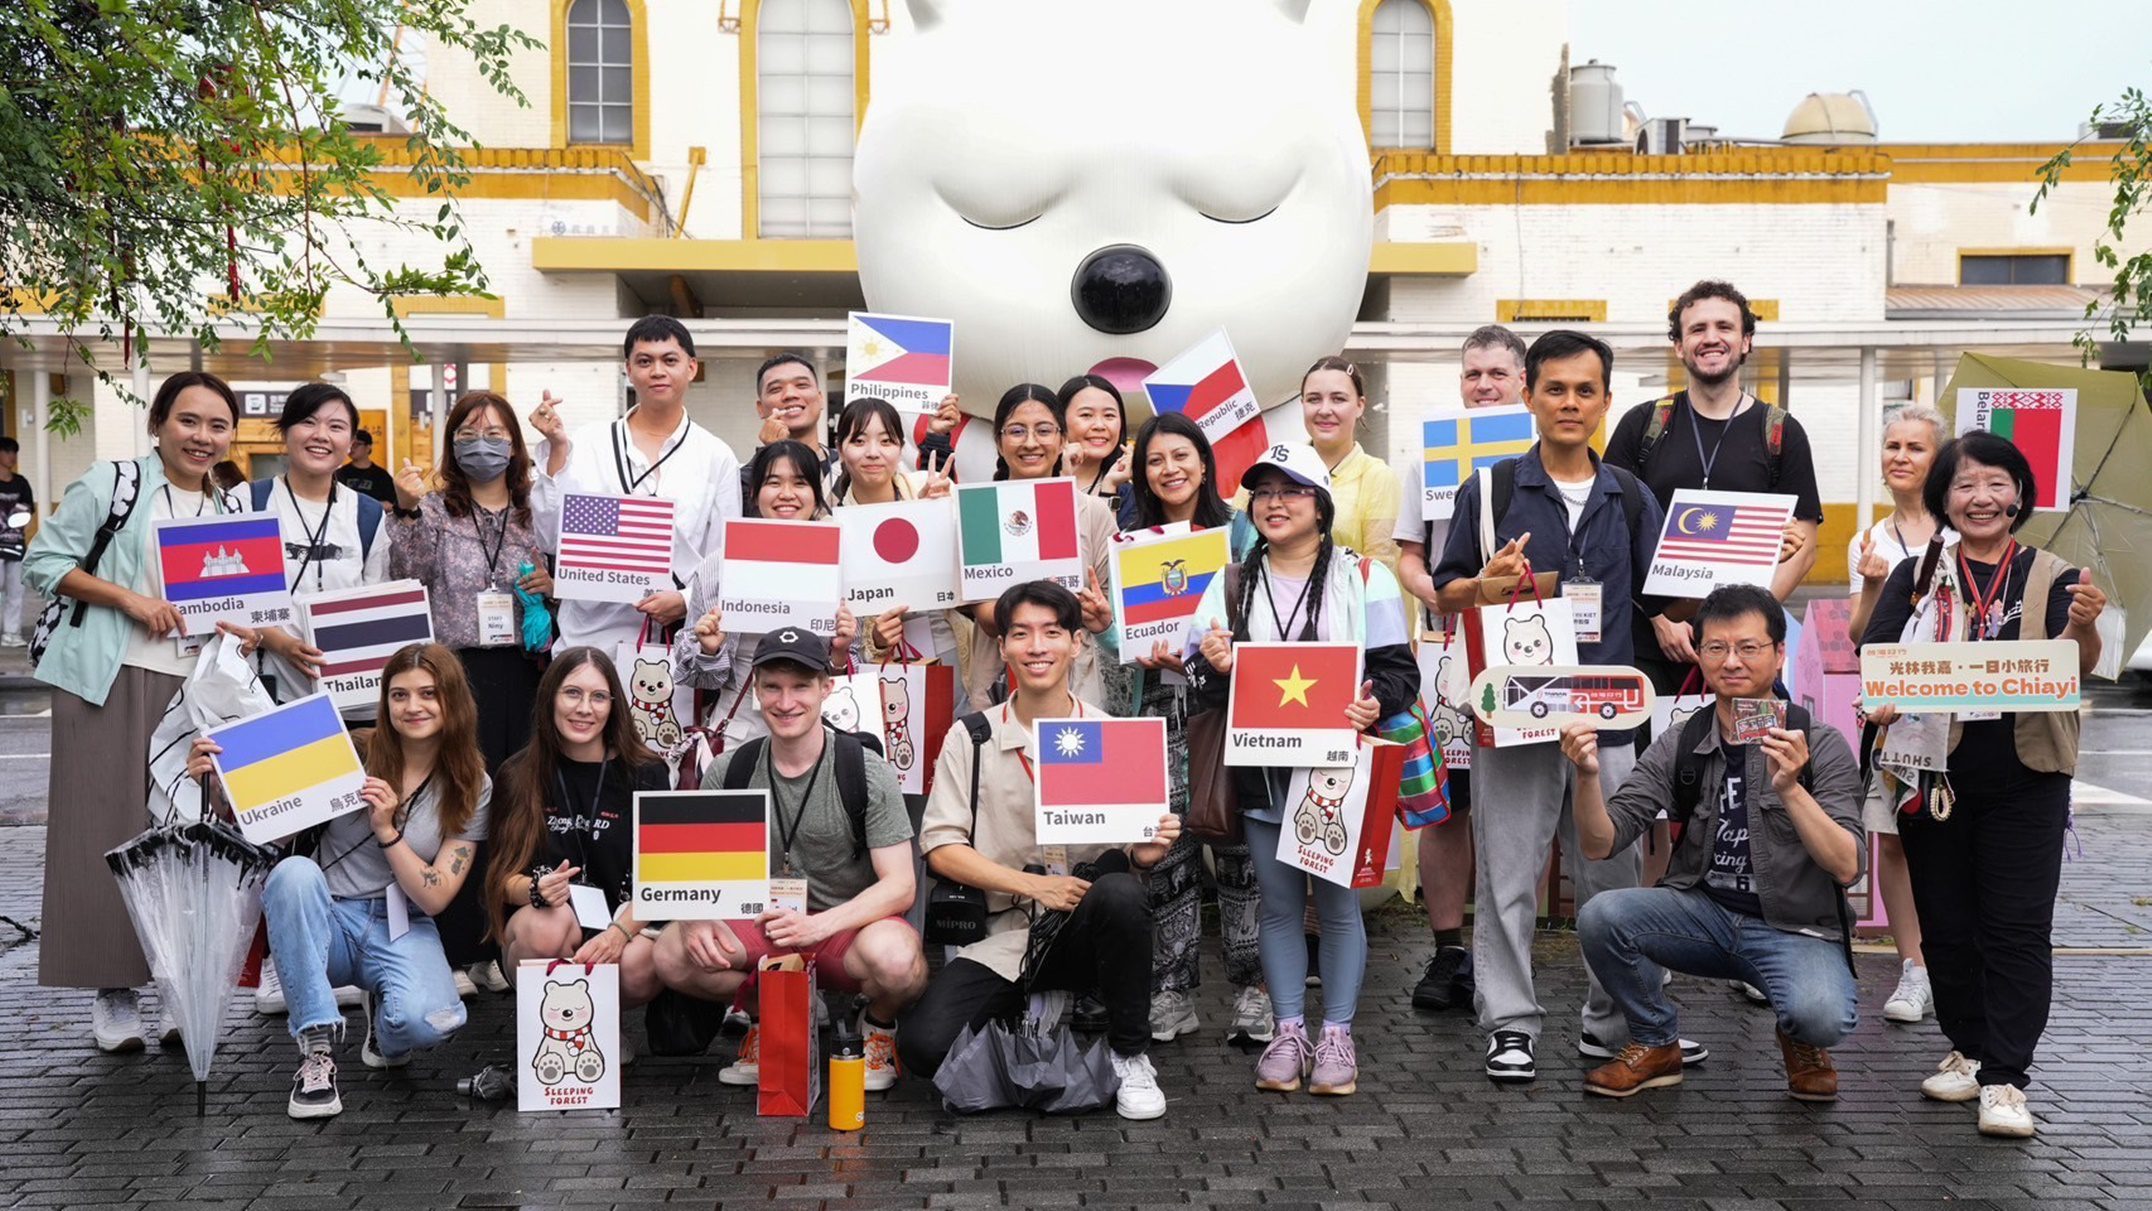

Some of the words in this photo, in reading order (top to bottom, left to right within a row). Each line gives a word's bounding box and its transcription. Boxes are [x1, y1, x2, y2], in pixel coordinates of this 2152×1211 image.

[851, 383, 928, 399] Philippines
[1234, 401, 1256, 421] 捷克
[1270, 444, 1290, 462] TS
[1425, 489, 1457, 501] Swe
[558, 568, 604, 582] United
[607, 571, 650, 586] States
[964, 565, 1014, 580] Mexico
[1652, 564, 1713, 580] Malaysia
[847, 587, 894, 602] Japan
[174, 598, 245, 616] ambodia
[721, 599, 791, 614] Indonesia
[1126, 622, 1180, 640] Ecuador
[1866, 679, 1968, 697] Welcome
[1972, 681, 1997, 696] to
[2001, 676, 2077, 699] Chiayi
[1233, 733, 1302, 748] Vietnam
[1523, 729, 1556, 739] FOREST
[1326, 750, 1349, 761] 越南
[240, 797, 303, 825] Ukraine
[1043, 810, 1106, 825] Taiwan
[1297, 845, 1334, 866] SLEEPING
[1299, 857, 1328, 873] FOREST
[641, 887, 721, 904] Germany
[741, 903, 764, 914] 德國
[545, 1086, 594, 1096] SLEEPING
[550, 1096, 588, 1105] FOREST
